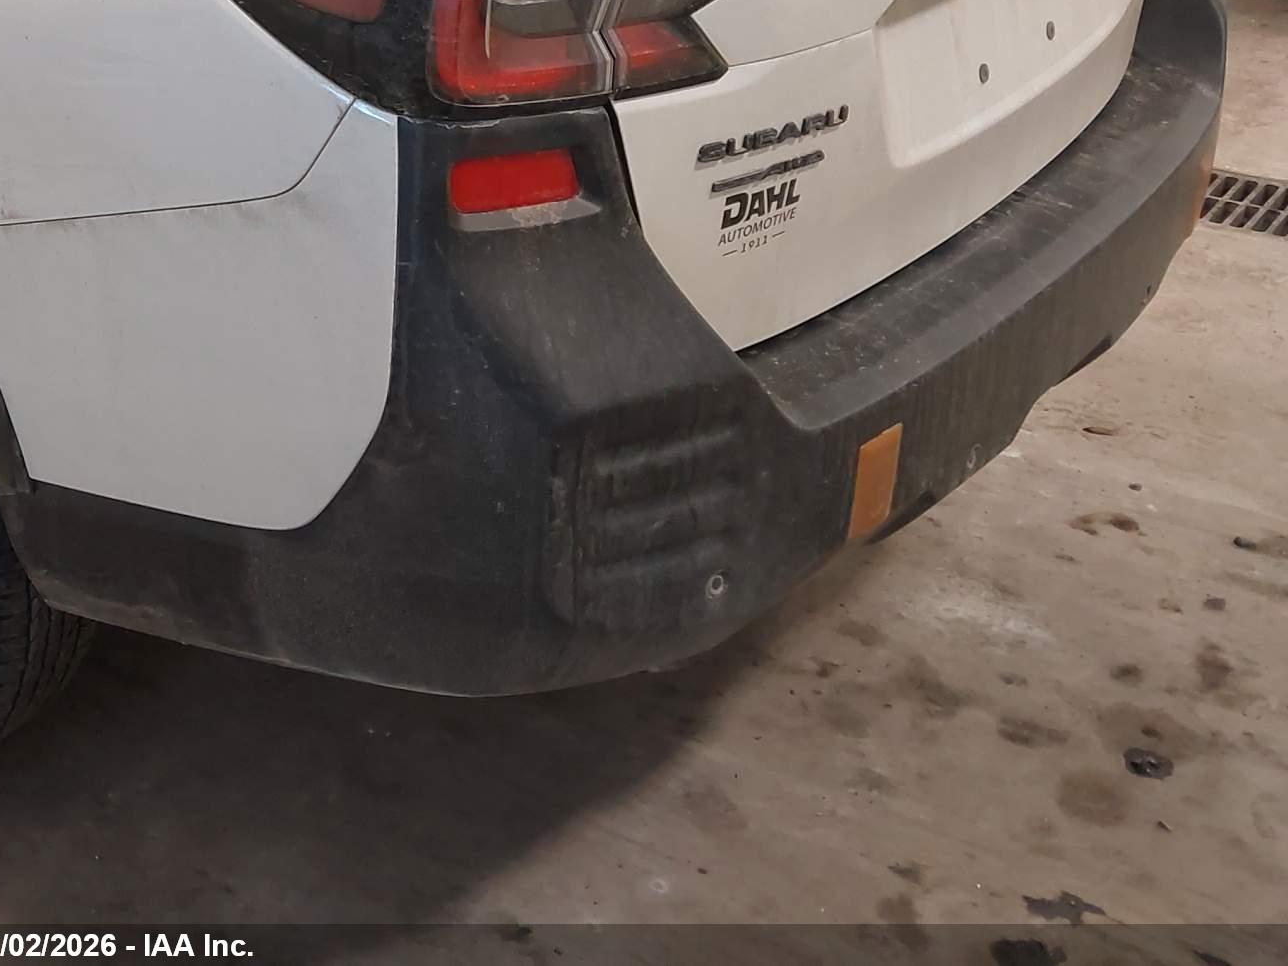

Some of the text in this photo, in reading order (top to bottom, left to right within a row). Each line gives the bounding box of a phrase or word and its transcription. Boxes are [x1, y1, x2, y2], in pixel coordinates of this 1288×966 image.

[697, 104, 849, 164] SUBARU
[717, 207, 798, 246] AUTOMOTIVE
[720, 178, 801, 230] DAHL
[741, 235, 768, 253] 1911
